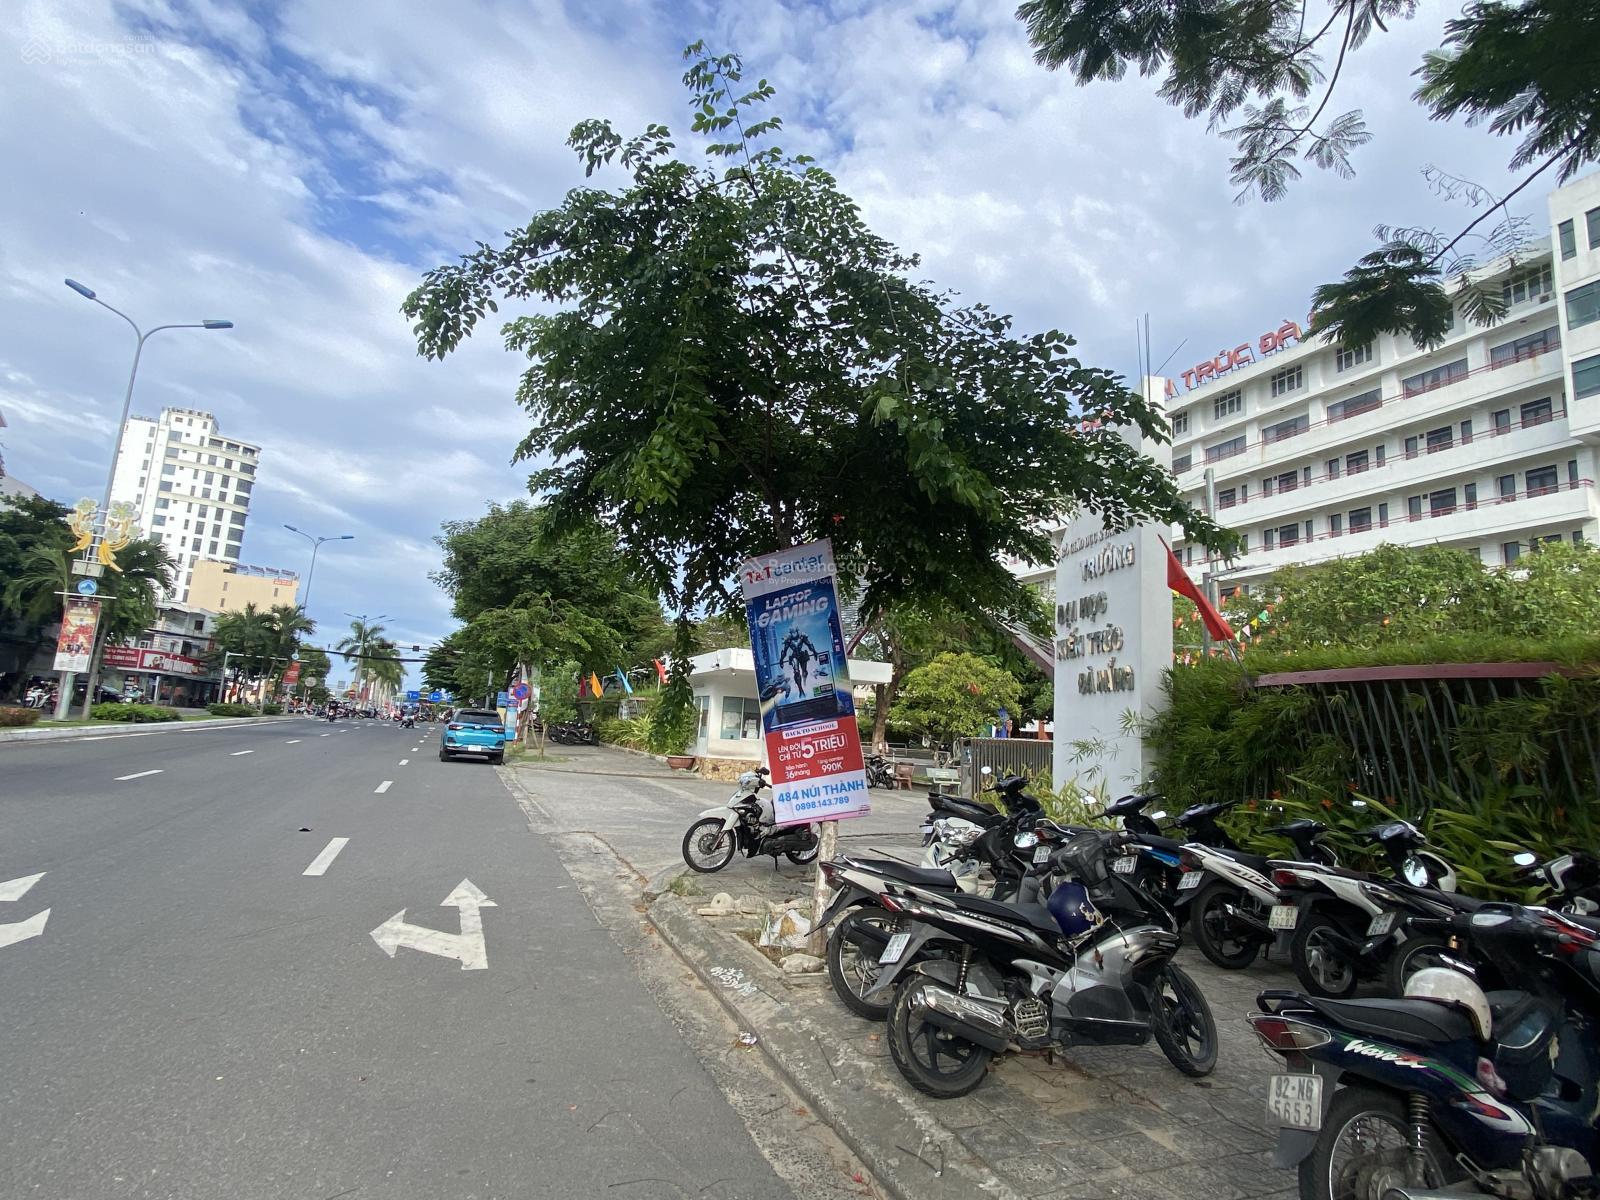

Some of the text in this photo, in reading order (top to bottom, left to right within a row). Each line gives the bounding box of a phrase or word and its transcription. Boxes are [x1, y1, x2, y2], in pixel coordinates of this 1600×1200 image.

[1181, 342, 1252, 391] TRÚC
[1259, 319, 1302, 355] ĐÀ
[765, 589, 812, 610] LAPTOP
[758, 597, 828, 628] GAMING
[785, 723, 836, 738] BACK TO SCHOOL
[800, 734, 845, 759] 5 TRIỆU
[821, 762, 844, 773] 990K
[778, 778, 865, 803] 484 NÚI THÀNH
[795, 796, 849, 811] 0898.143.789
[1344, 1039, 1402, 1061] Wave
[1273, 1101, 1313, 1126] 5653
